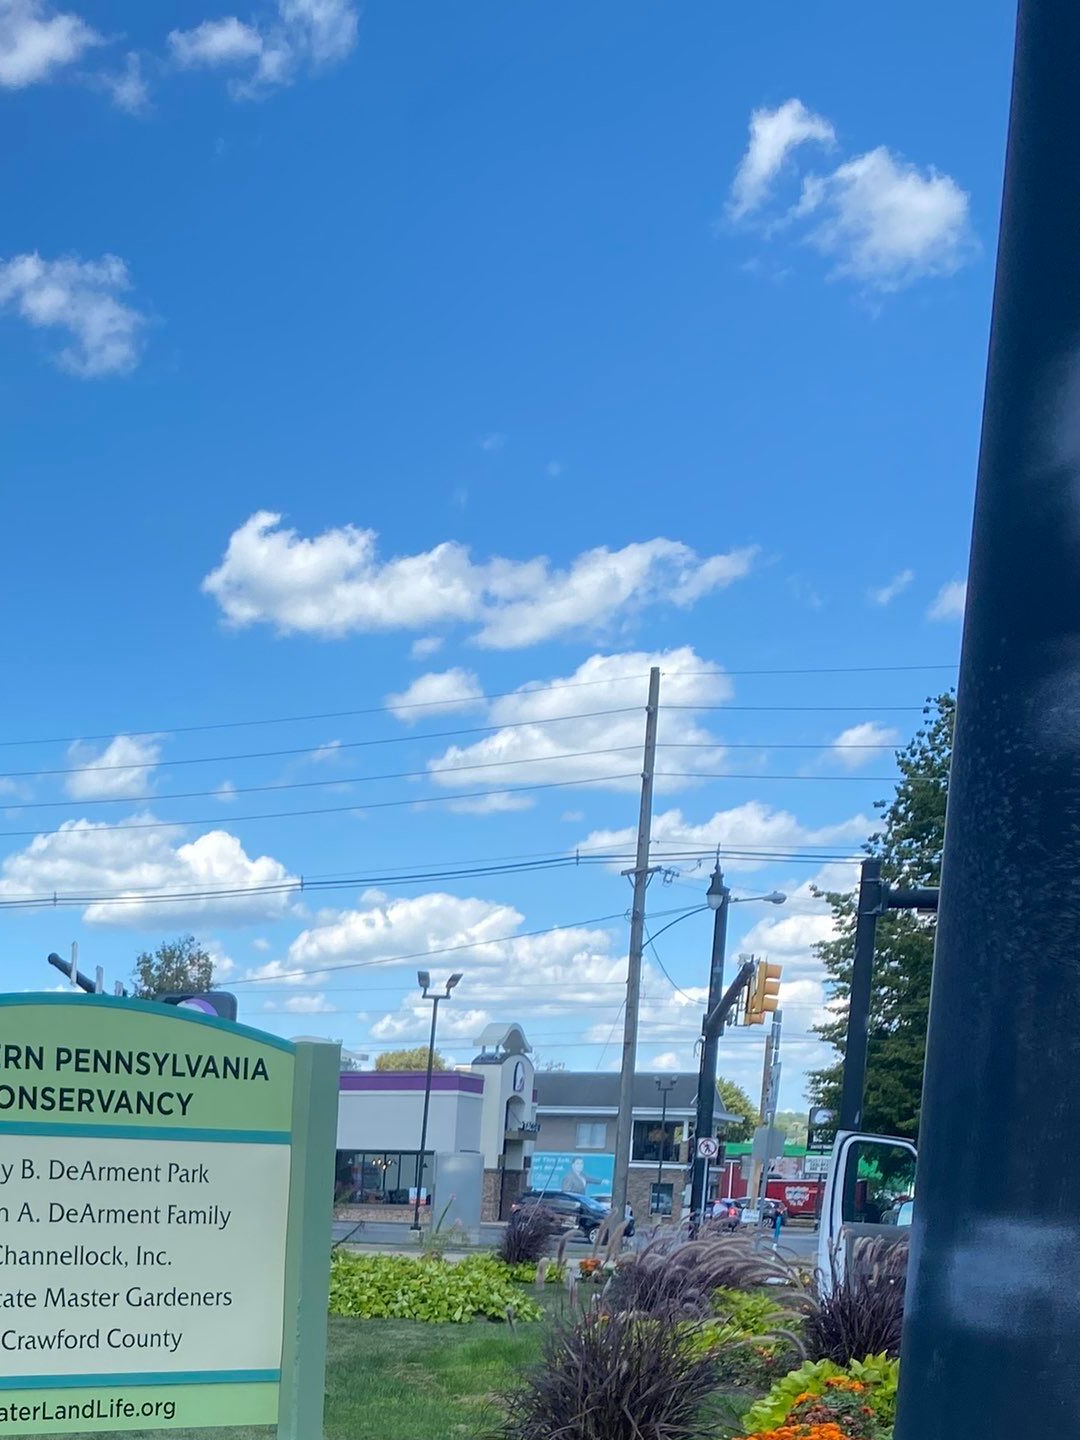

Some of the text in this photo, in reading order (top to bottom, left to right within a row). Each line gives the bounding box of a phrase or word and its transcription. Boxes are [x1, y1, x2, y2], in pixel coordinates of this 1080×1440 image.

[56, 1047, 269, 1081] PENNSYLVANIA
[22, 1159, 39, 1179] B.
[49, 1160, 161, 1182] DeArment
[168, 1163, 209, 1183] Park
[18, 1203, 39, 1222] A.
[49, 1203, 160, 1224] DeArment
[168, 1205, 231, 1230] Family
[137, 1246, 171, 1265] Inc.
[44, 1288, 119, 1307] Master
[126, 1287, 232, 1306] Gardeners
[2, 1329, 99, 1350] Crawford
[107, 1329, 182, 1352] County
